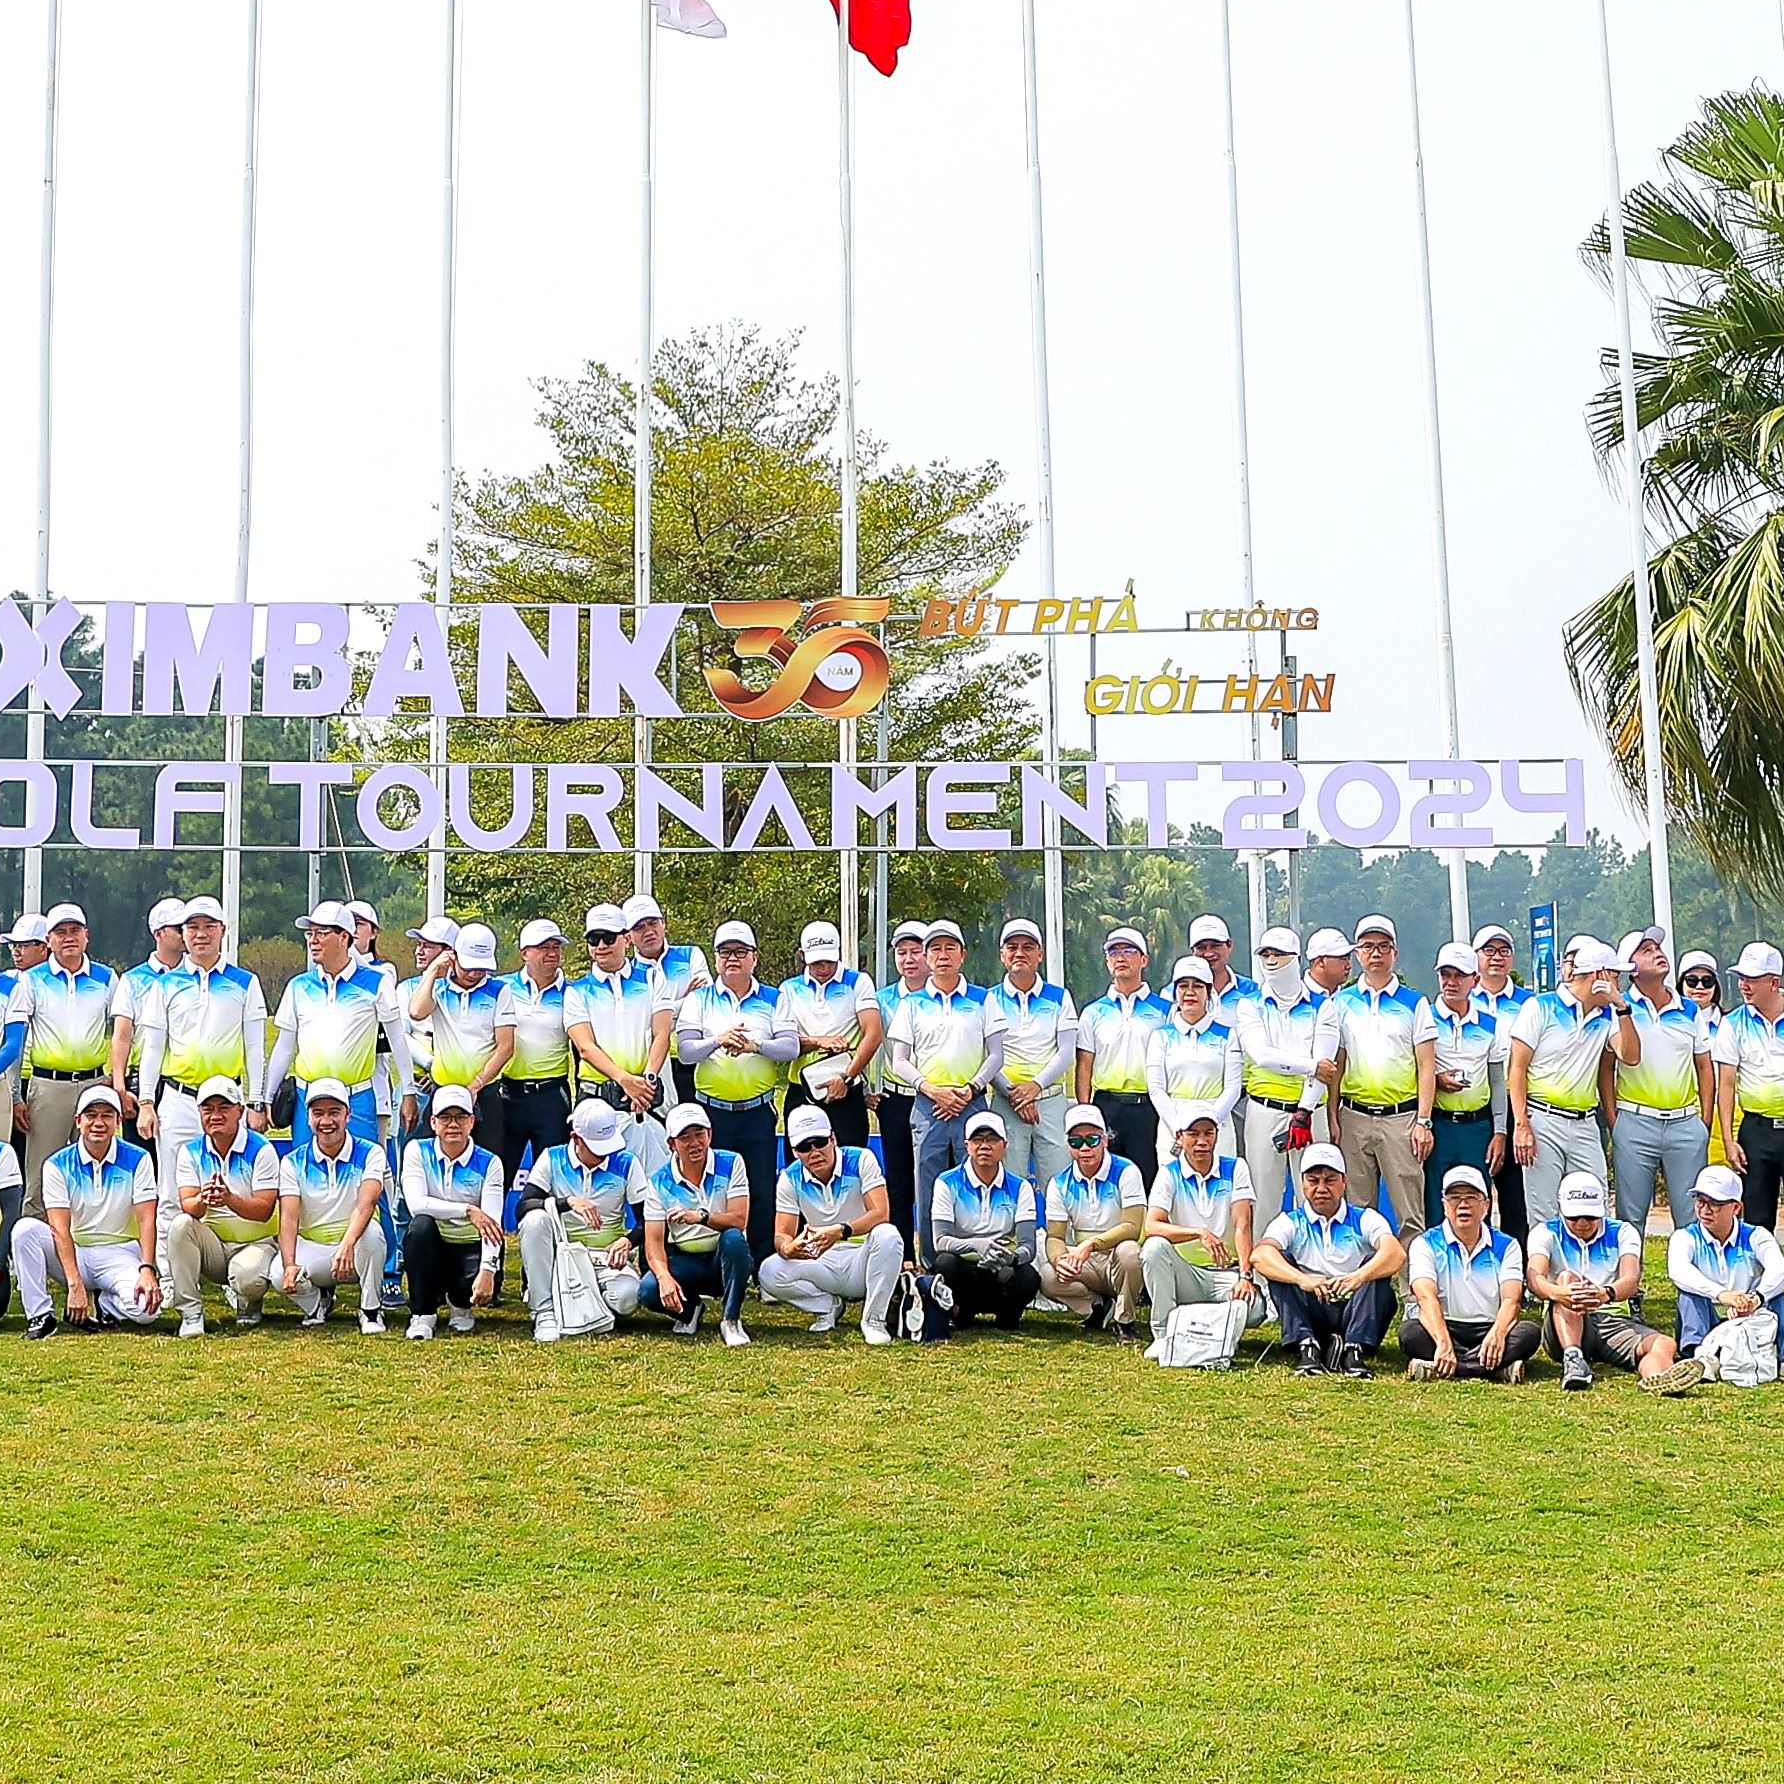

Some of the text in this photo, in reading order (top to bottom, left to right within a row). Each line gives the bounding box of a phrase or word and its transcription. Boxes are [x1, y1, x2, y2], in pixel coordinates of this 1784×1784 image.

[1032, 578, 1138, 634] PHÁ
[1200, 600, 1320, 631] KHÔNG
[1084, 658, 1336, 730] GIỚI HẠN
[269, 759, 1198, 852] TOURNAMENT
[1222, 758, 1585, 849] 2024
